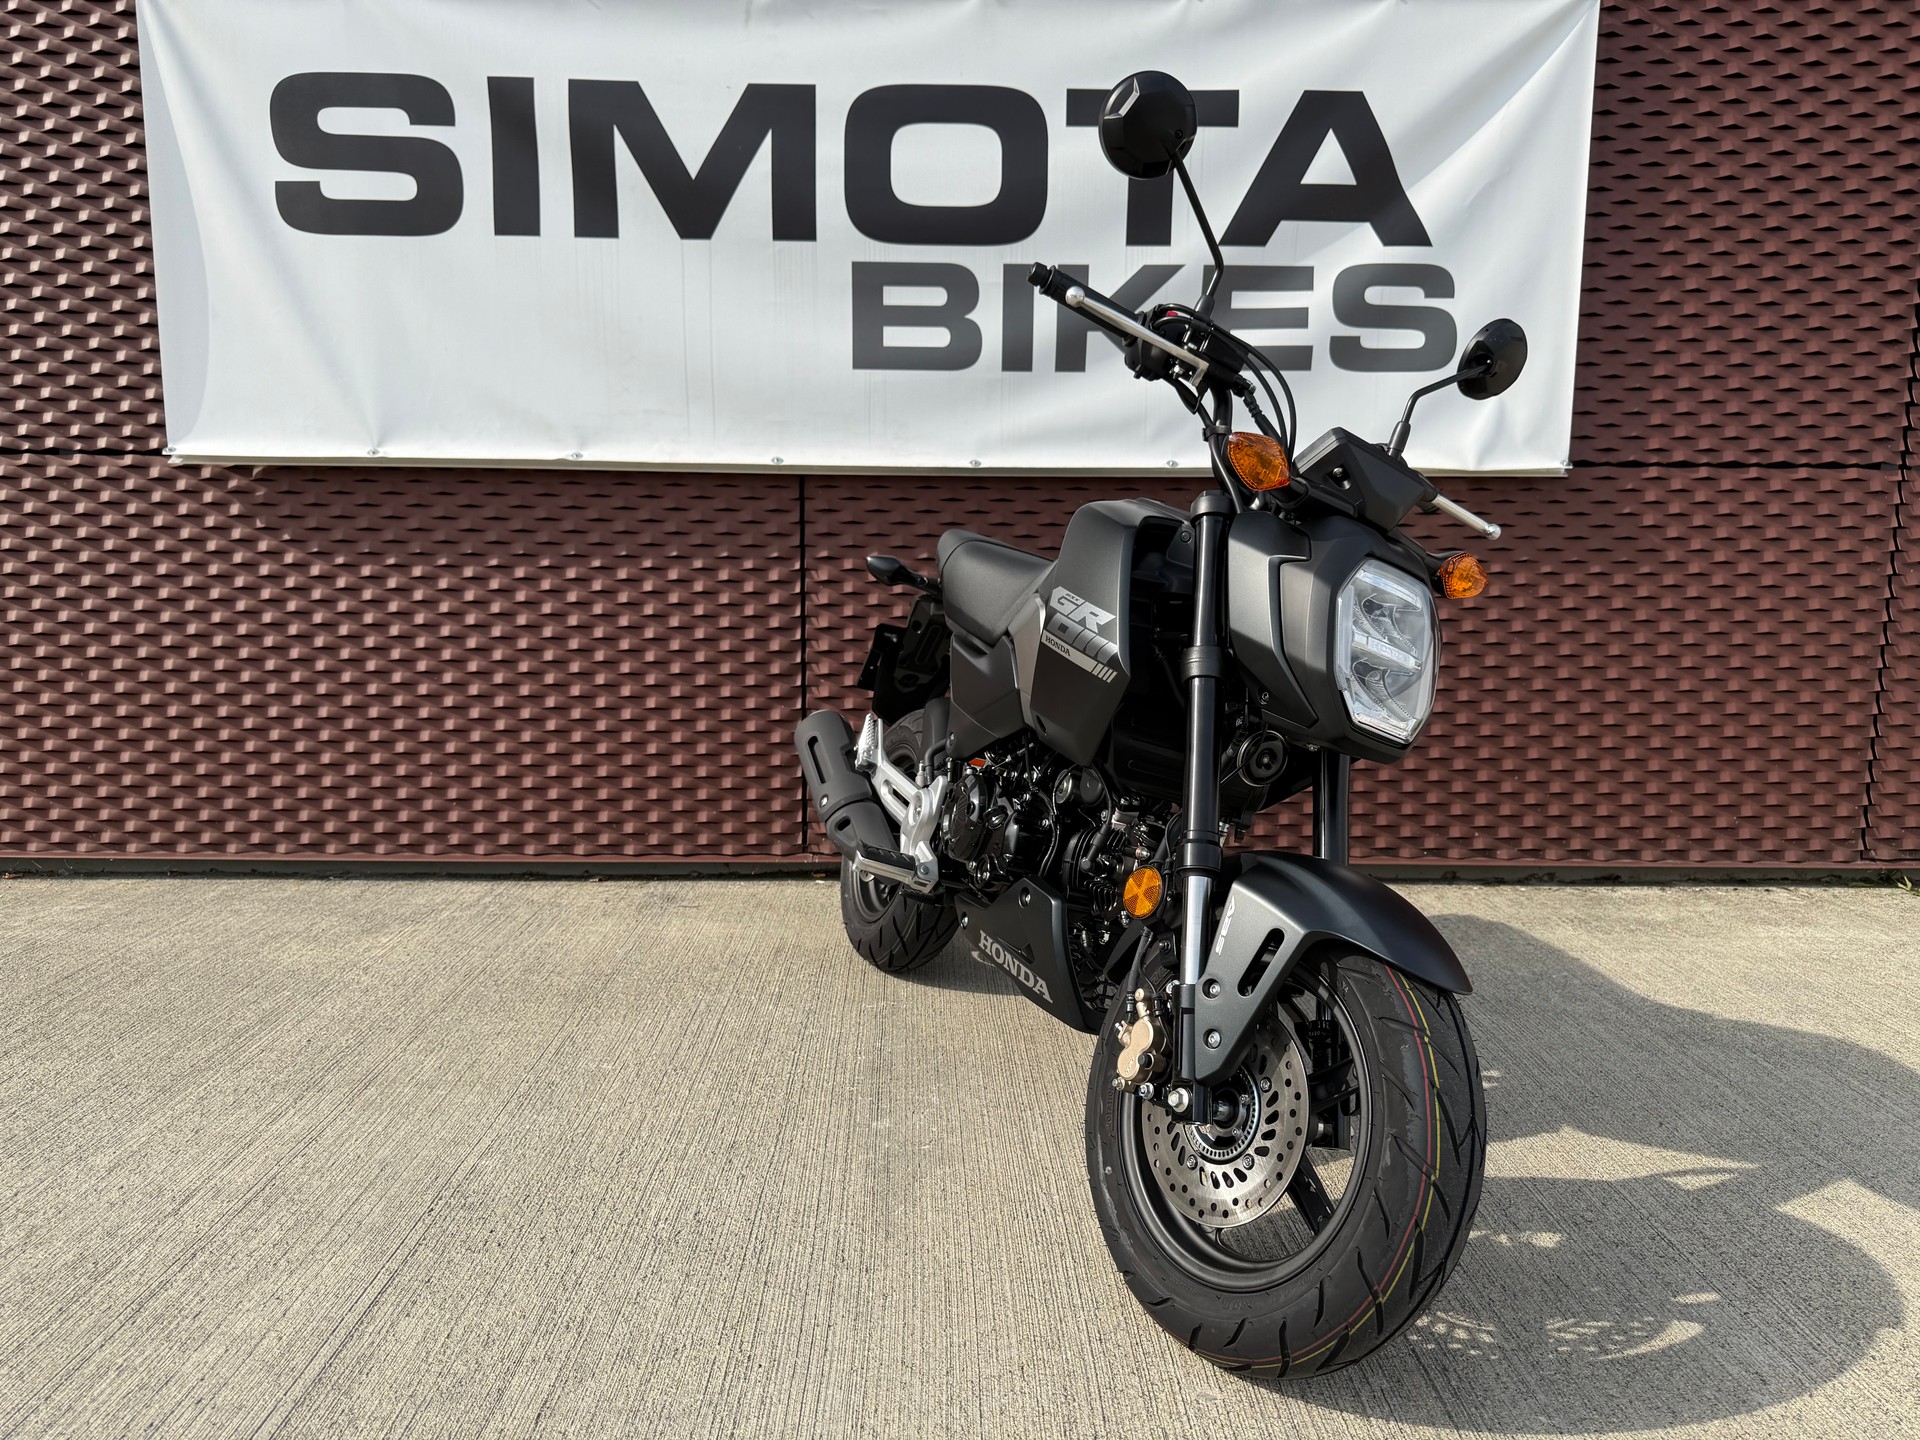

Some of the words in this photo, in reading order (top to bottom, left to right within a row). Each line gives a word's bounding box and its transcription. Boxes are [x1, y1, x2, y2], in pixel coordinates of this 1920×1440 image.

[270, 72, 1433, 247] SIMOTA
[851, 261, 1457, 373] BIKES
[1045, 635, 1071, 657] HONDA
[1215, 894, 1235, 956] ABS
[979, 930, 1053, 1004] HONDA
